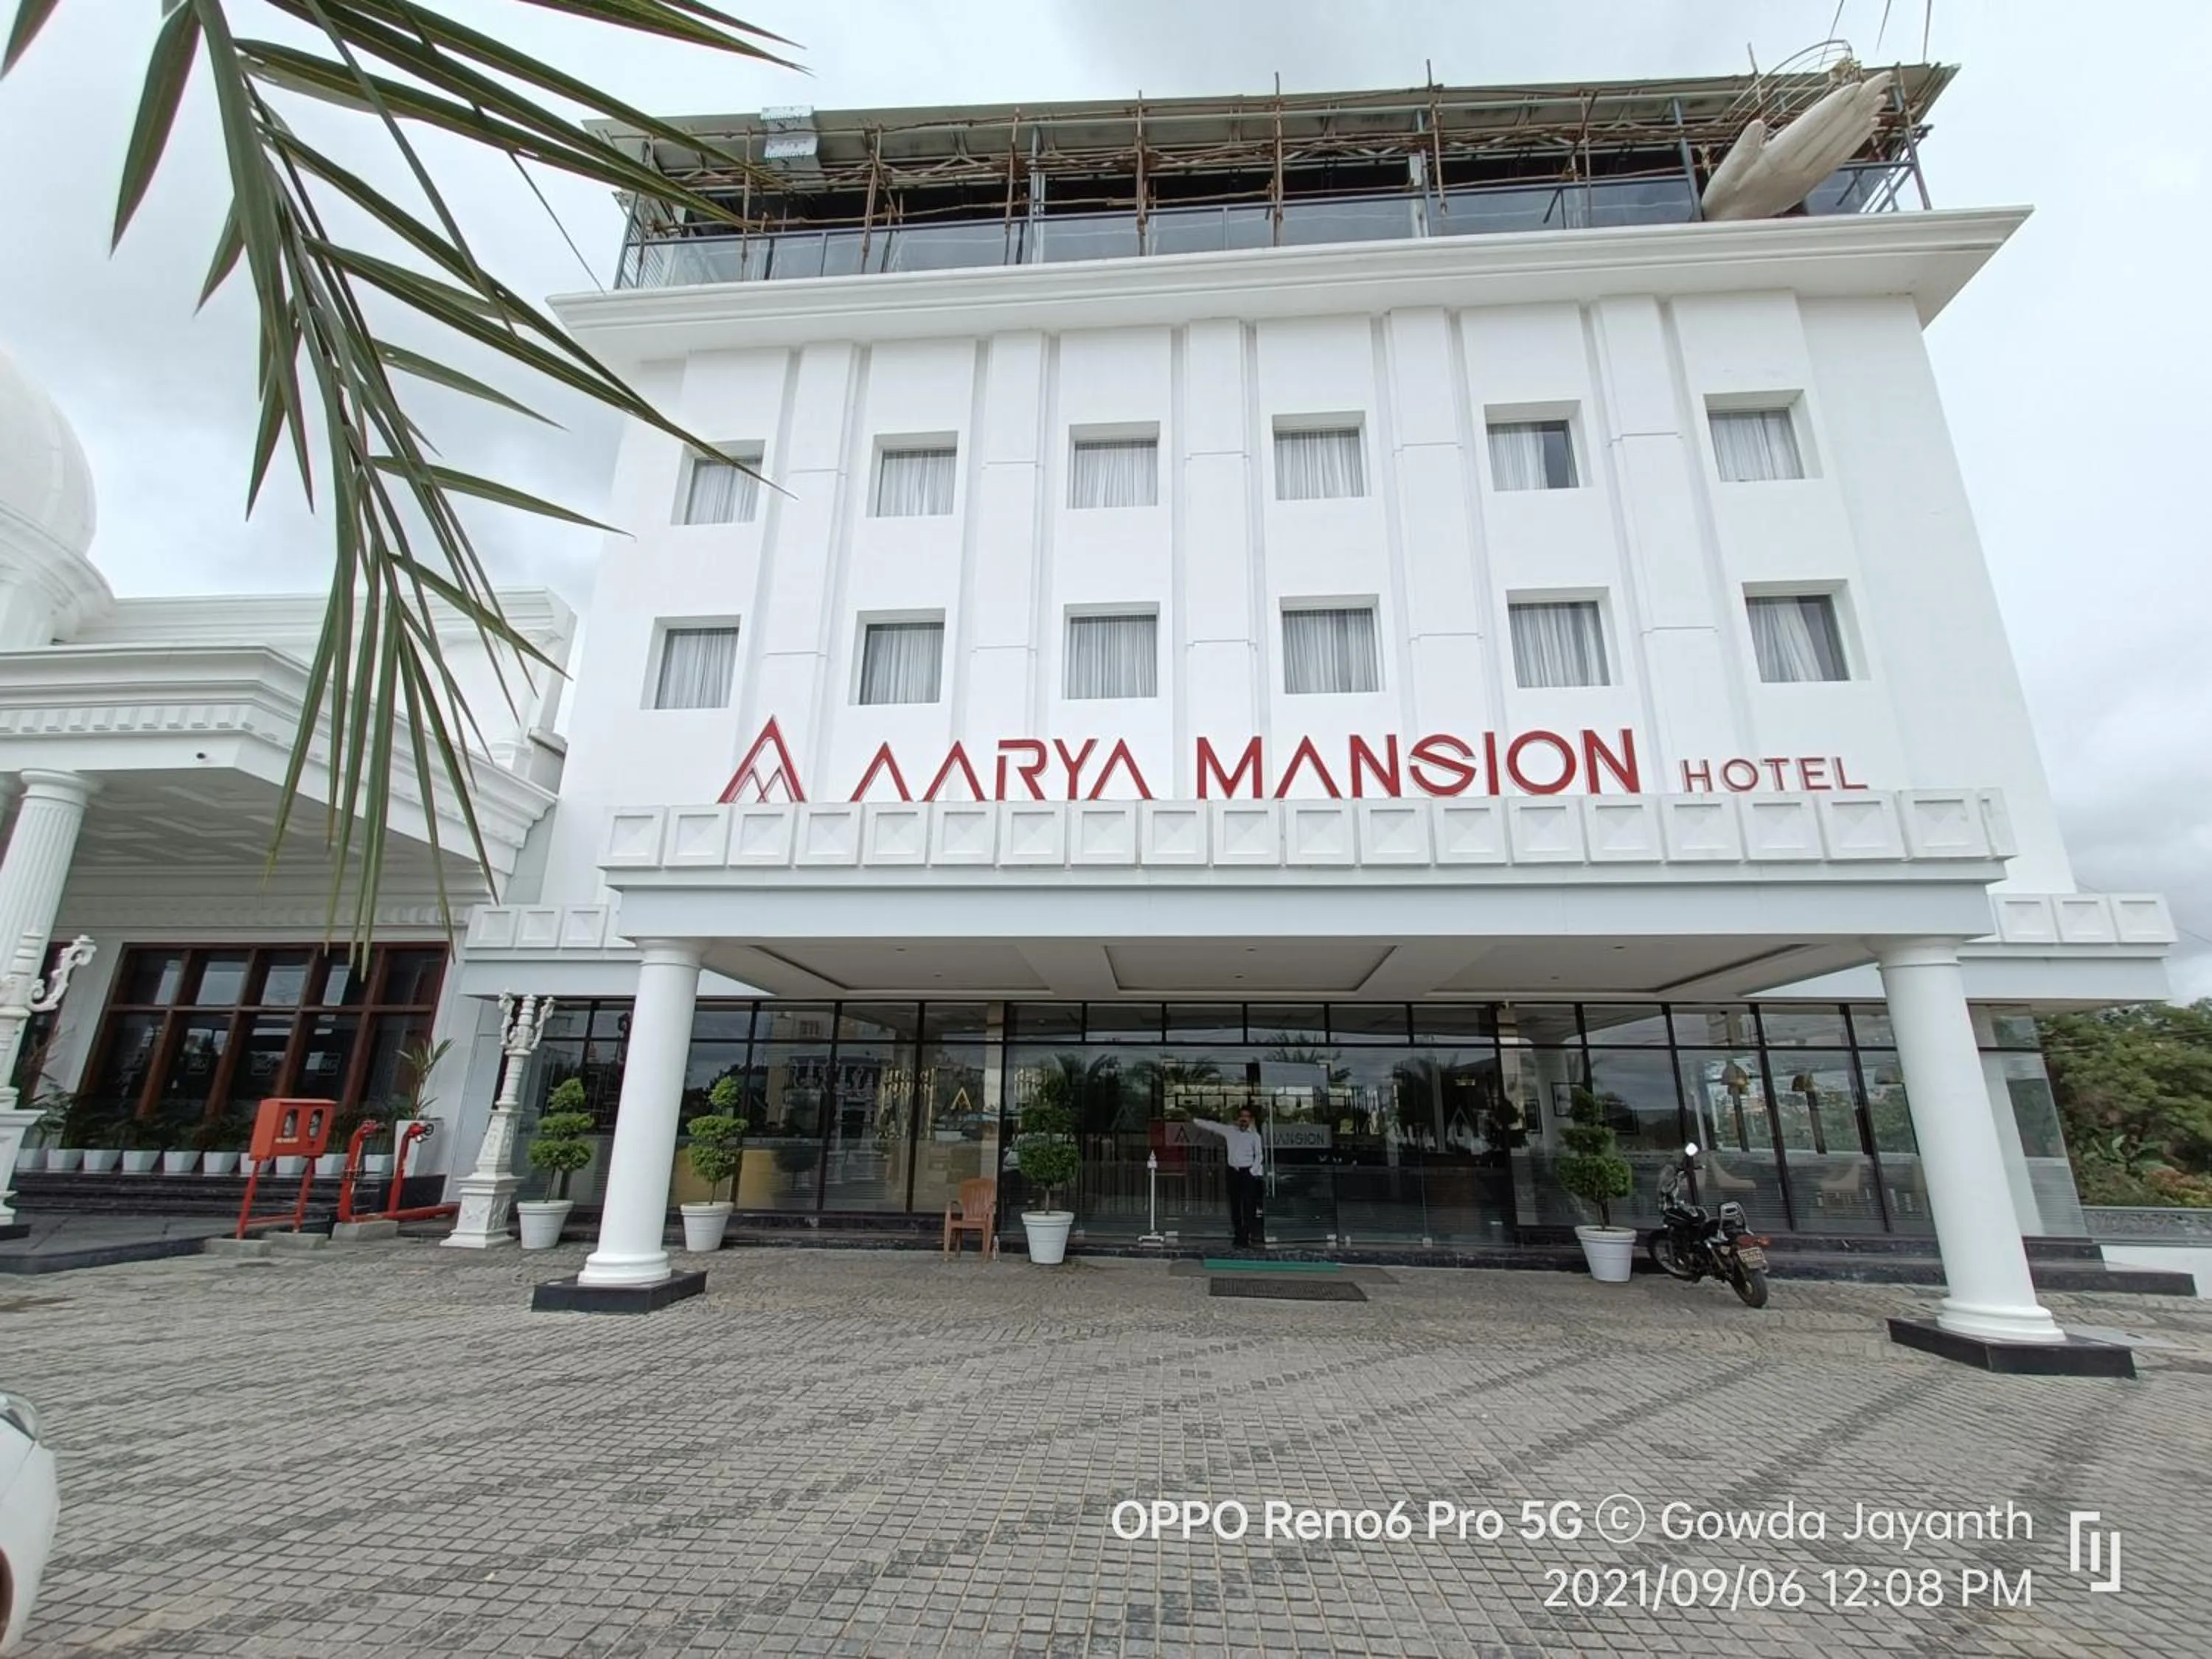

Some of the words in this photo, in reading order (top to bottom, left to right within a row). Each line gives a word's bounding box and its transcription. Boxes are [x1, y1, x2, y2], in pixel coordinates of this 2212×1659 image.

[849, 738, 1154, 802] AARYA
[1196, 729, 1641, 799] MANSION
[1680, 757, 1868, 793] HOTEL
